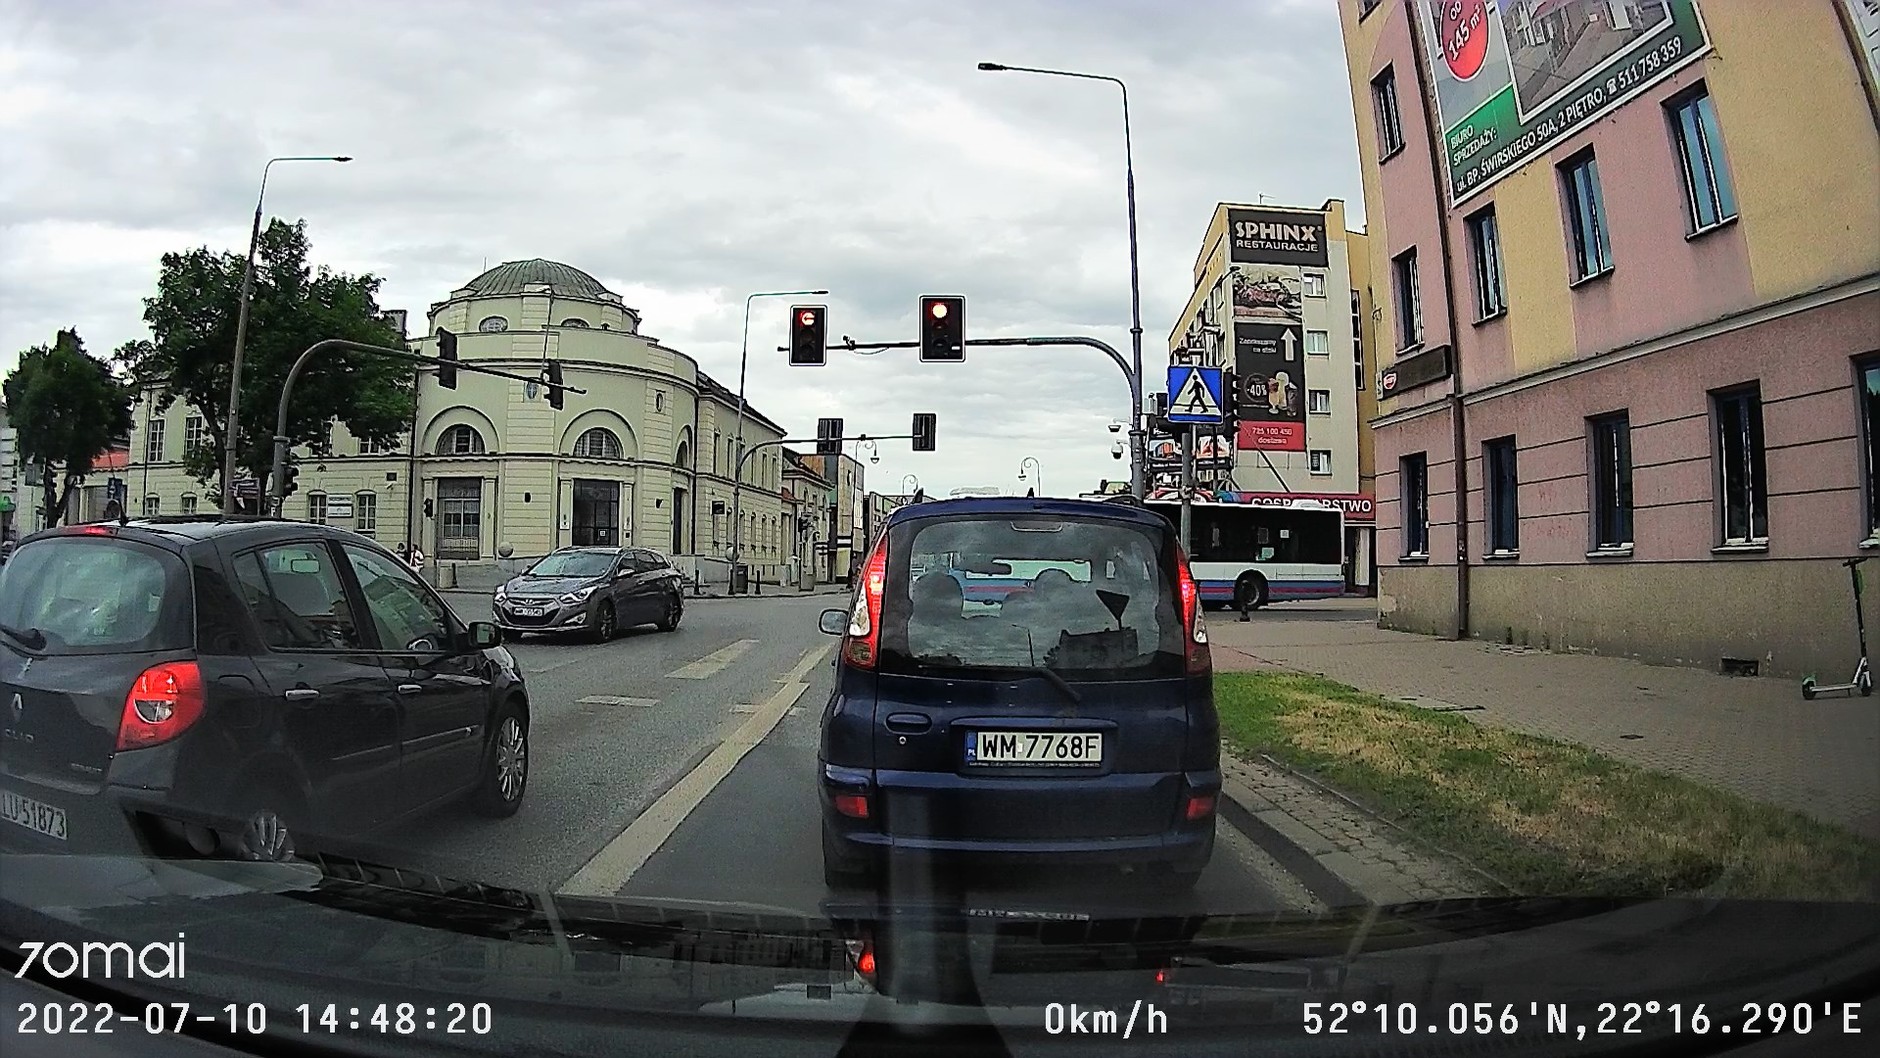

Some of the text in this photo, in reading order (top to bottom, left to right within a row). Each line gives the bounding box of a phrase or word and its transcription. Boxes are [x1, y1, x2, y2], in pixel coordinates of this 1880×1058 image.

[1449, 19, 1470, 61] 145
[1480, 131, 1536, 176] ŚWIRSKIEGO
[1536, 118, 1559, 141] 50A,
[1557, 111, 1566, 128] 2
[1565, 88, 1607, 121] PIĘTRO,
[1618, 65, 1640, 89] 511
[1639, 51, 1660, 76] 758
[1660, 36, 1681, 61] 359
[1450, 125, 1474, 150] BIURO
[1453, 127, 1498, 166] SPRZEDAŻY:
[1236, 239, 1319, 252] RESTAURACJE
[983, 735, 1099, 758] WM 7768F
[22, 799, 65, 837] 51873
